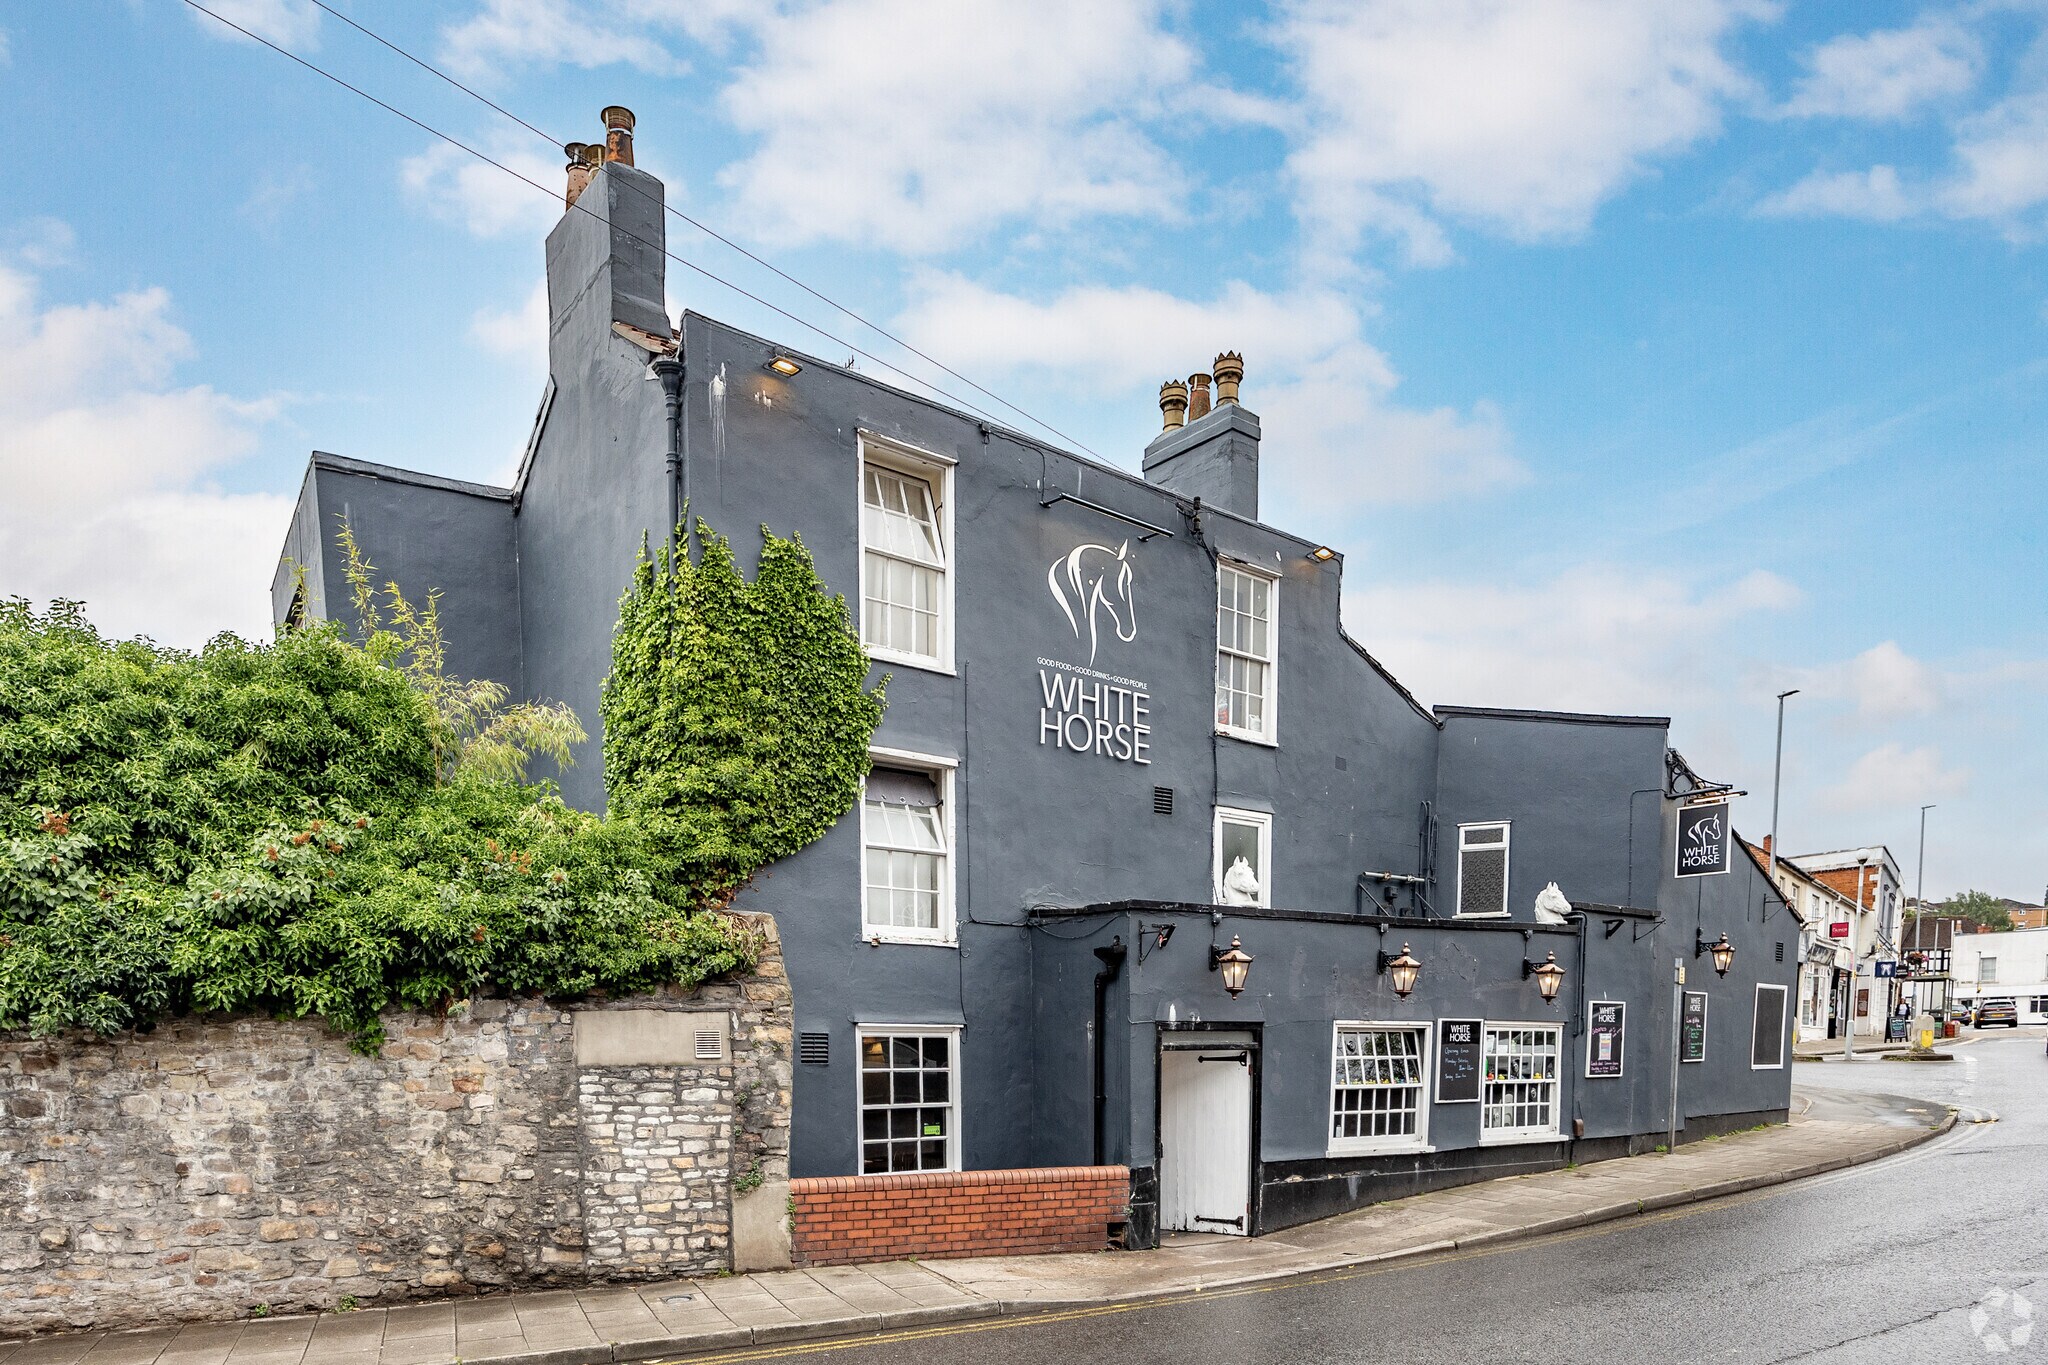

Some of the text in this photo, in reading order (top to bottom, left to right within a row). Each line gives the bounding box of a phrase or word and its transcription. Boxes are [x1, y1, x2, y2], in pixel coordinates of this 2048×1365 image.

[1036, 656, 1148, 690] GOOD FOOD GOOD DRINKS GOOD PEOPLE
[1039, 669, 1151, 729] WHITE
[1039, 707, 1152, 764] HORSE
[1683, 844, 1719, 857] WHITE
[1682, 854, 1720, 867] HORSE
[1599, 1006, 1616, 1015] WHITE
[1598, 1014, 1616, 1023] HORSE
[1450, 1024, 1471, 1034] WHITE
[1449, 1033, 1471, 1042] HORSE
